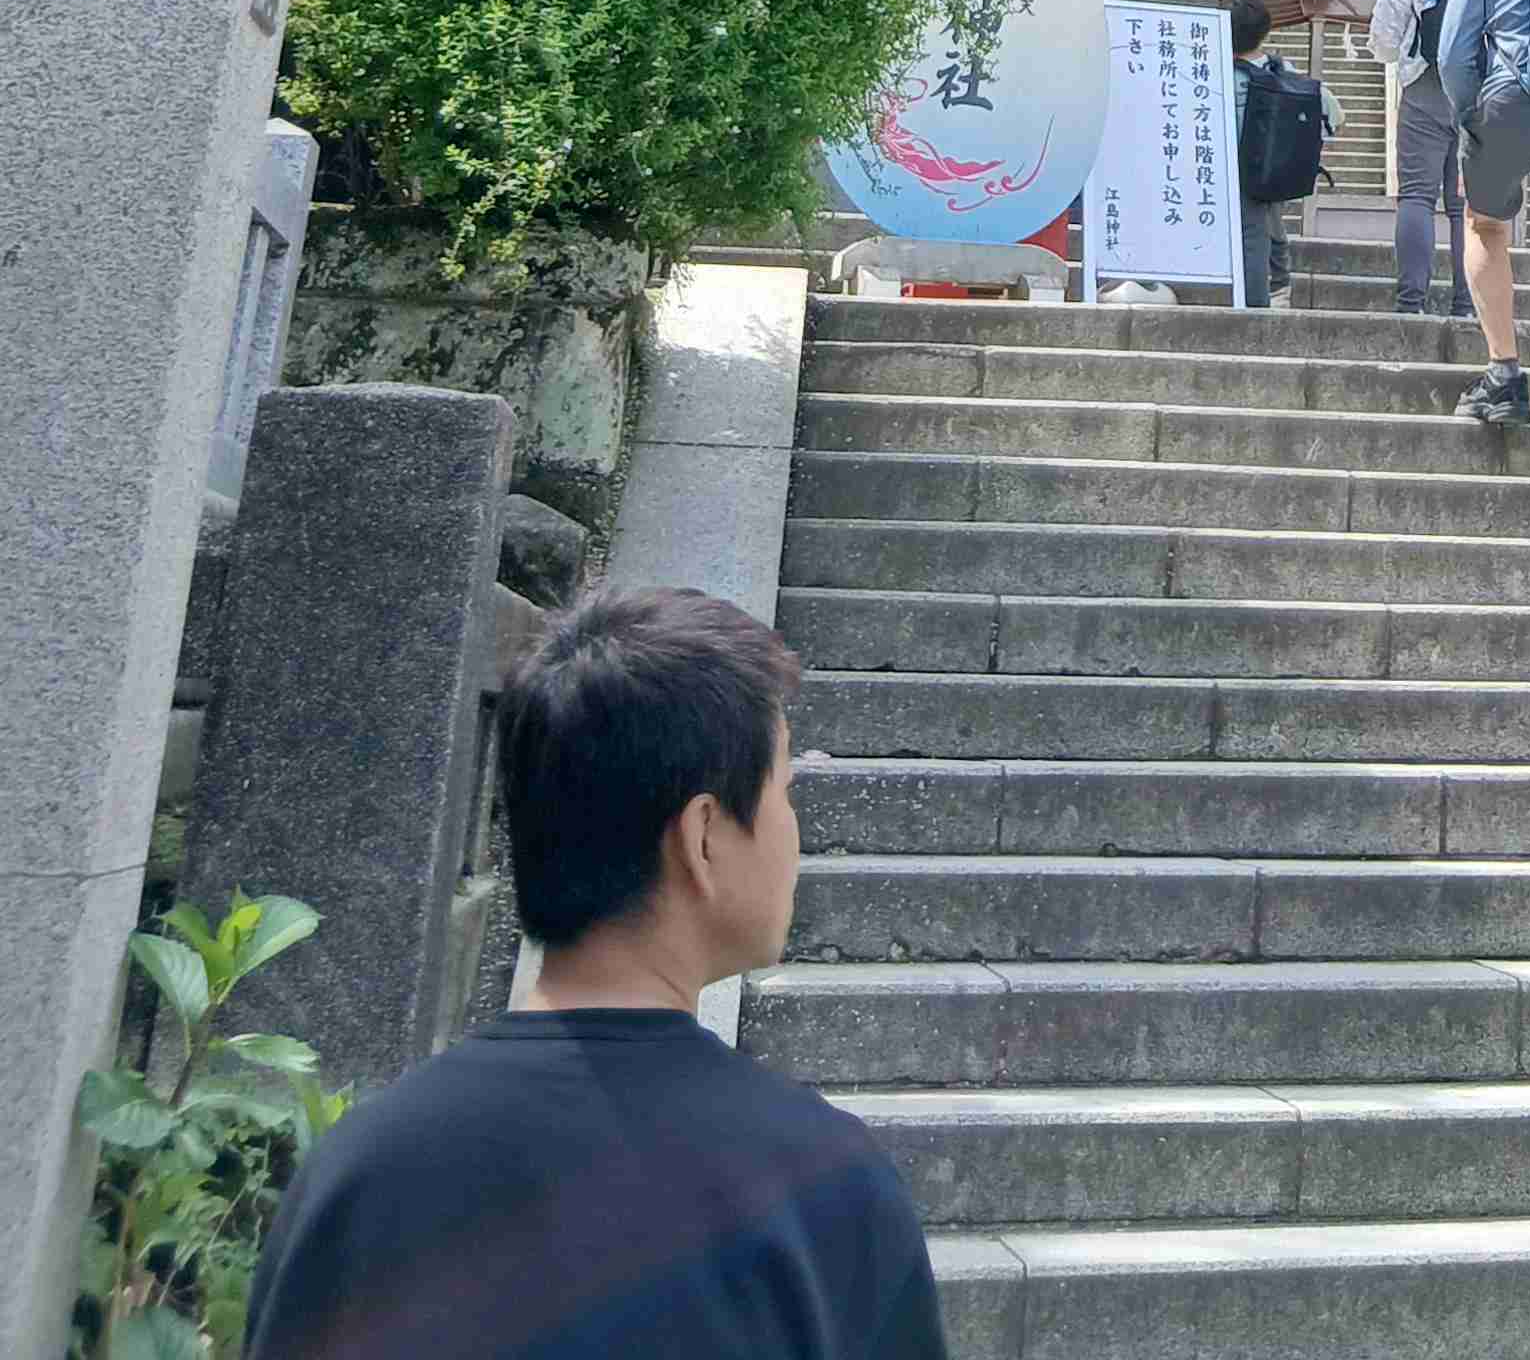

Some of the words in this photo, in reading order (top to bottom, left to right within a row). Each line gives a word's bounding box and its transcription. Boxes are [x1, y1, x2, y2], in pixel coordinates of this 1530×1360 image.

[1125, 18, 1144, 75] 下さい
[1158, 19, 1183, 226] 社務所にてお申し込み
[1190, 22, 1216, 227] 御祈祷の方は階段上の
[1104, 187, 1120, 251] 江島神社
